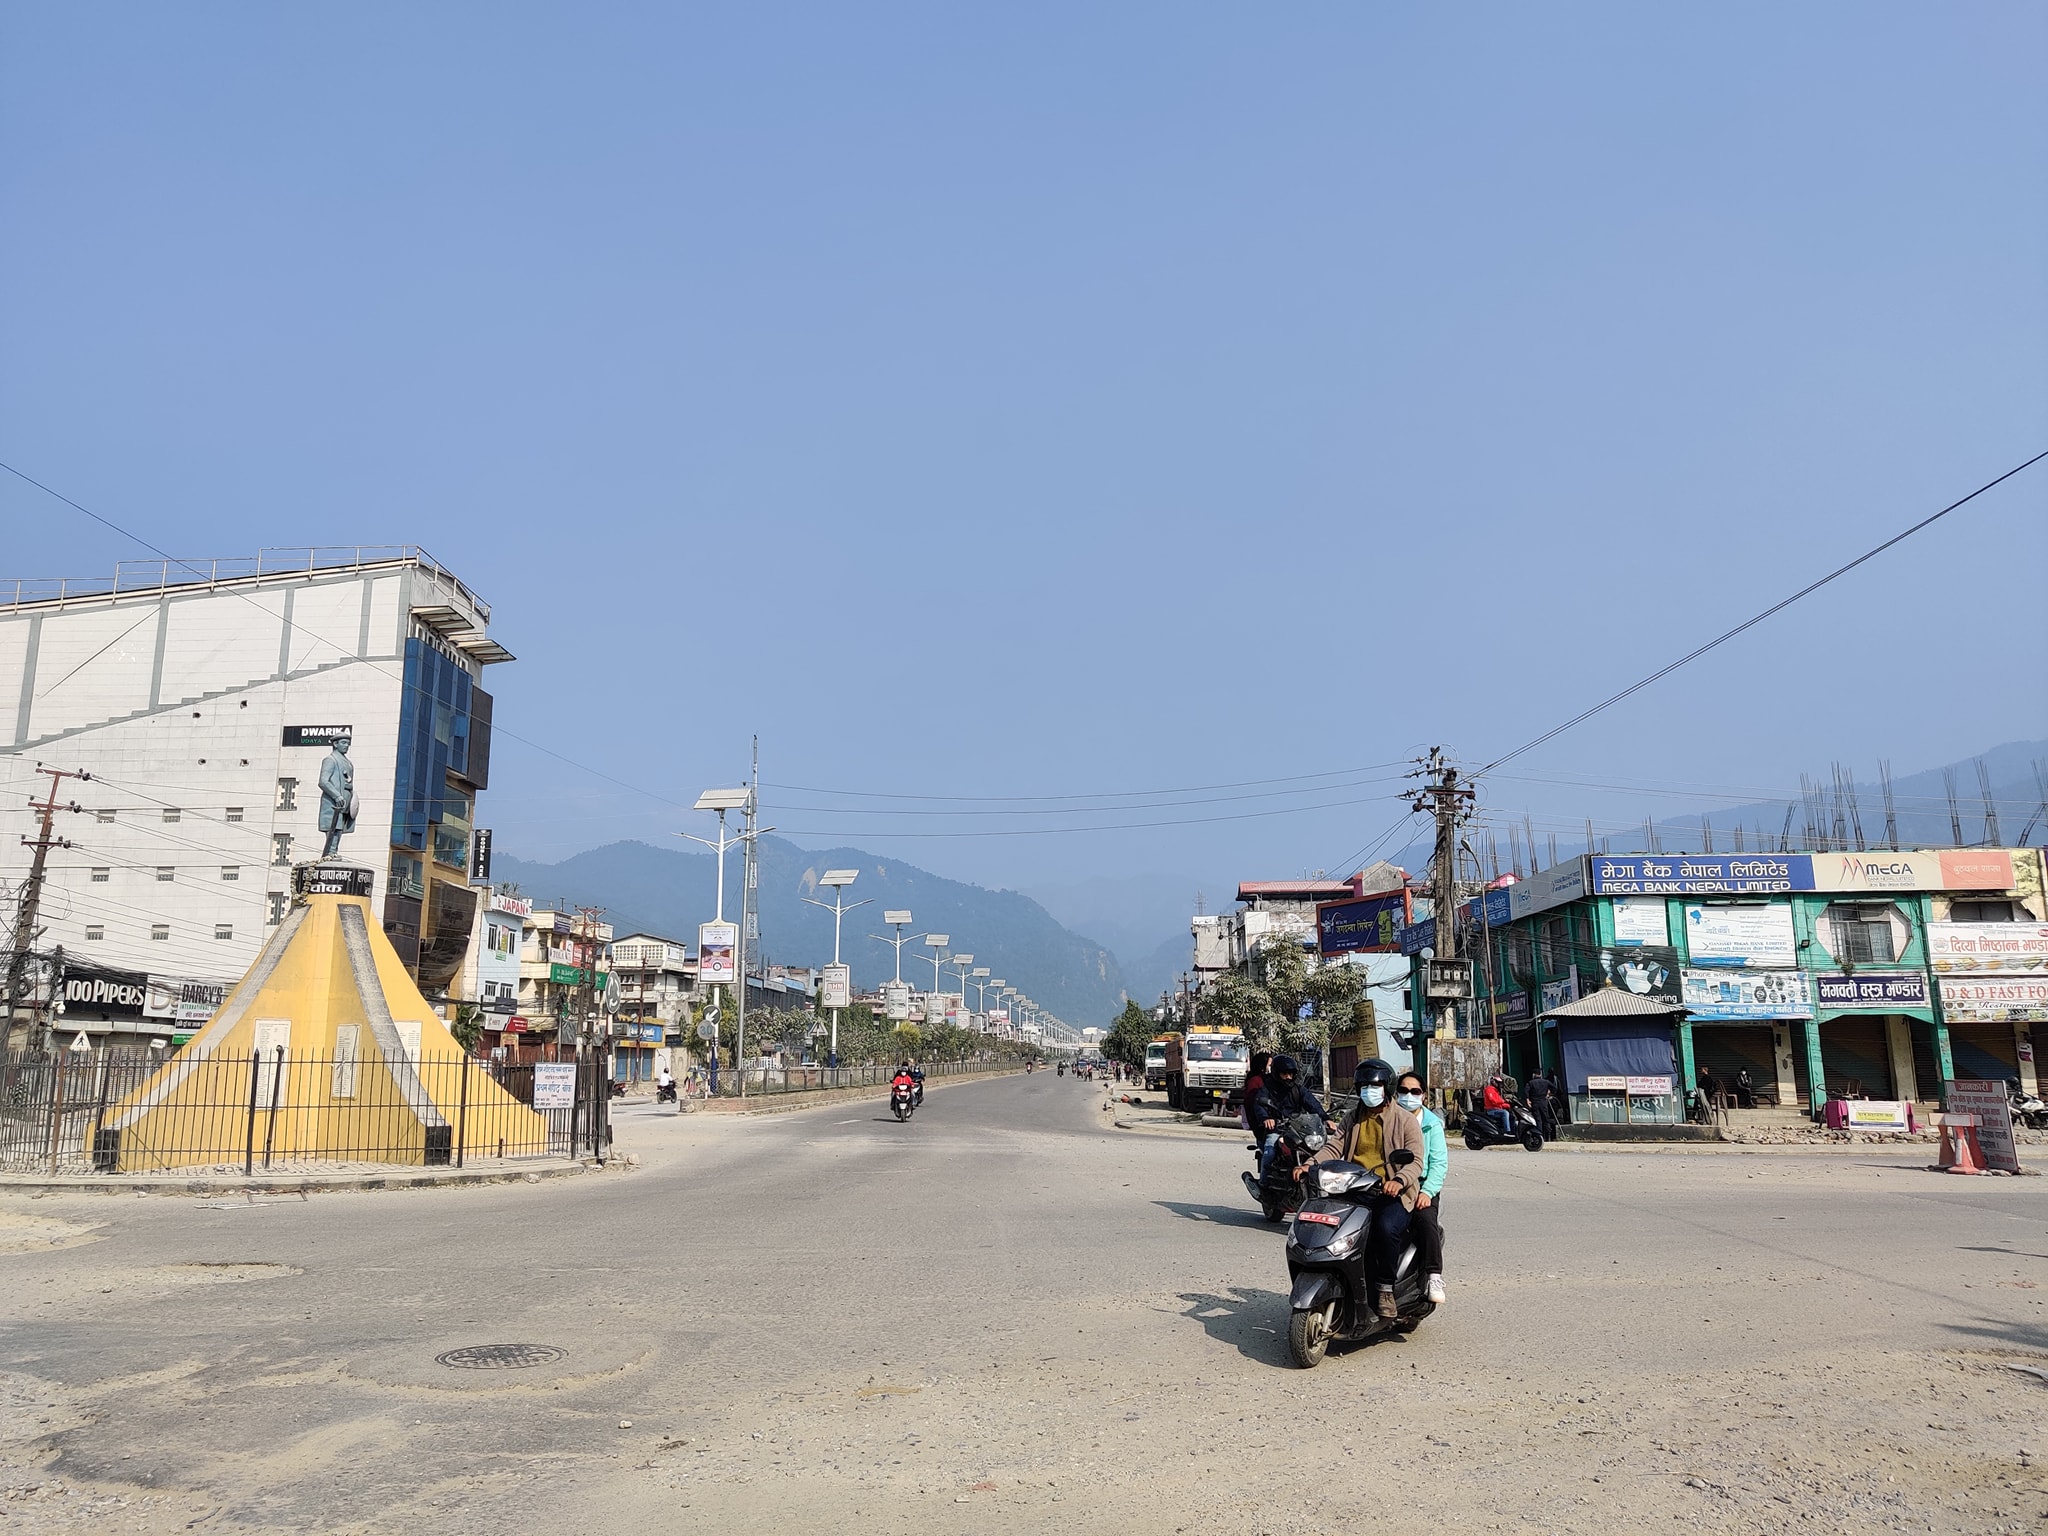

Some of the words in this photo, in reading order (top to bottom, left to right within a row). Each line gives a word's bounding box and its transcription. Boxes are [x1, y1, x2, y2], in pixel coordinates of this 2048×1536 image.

[301, 727, 351, 737] DWARIKA
[1601, 861, 1635, 878] मेगा
[1643, 860, 1672, 877] बैंक
[1679, 860, 1722, 877] नेपाल
[1729, 859, 1788, 877] लिमिटेड
[1866, 863, 1914, 875] MEGA
[1602, 881, 1641, 892] MEGA
[1644, 881, 1682, 892] BANK
[1686, 881, 1733, 892] NEPAL
[1737, 880, 1791, 891] LIMITED
[502, 899, 526, 915] JAPAN
[1950, 935, 1976, 952] दिव्या
[1979, 935, 2020, 952] मिष्ठान्न
[2022, 939, 2048, 952] भण्डा
[181, 984, 223, 1004] DARCY'S
[1820, 979, 1857, 998] भगवती
[1860, 983, 1883, 998] वस्त्र
[1885, 983, 1922, 997] भण्डार
[1945, 987, 1956, 999] D
[1960, 987, 1970, 999] &
[1973, 986, 1985, 999] D
[1988, 986, 2025, 999] FAST
[2027, 985, 2048, 999] FO
[700, 1025, 713, 1035] 30
